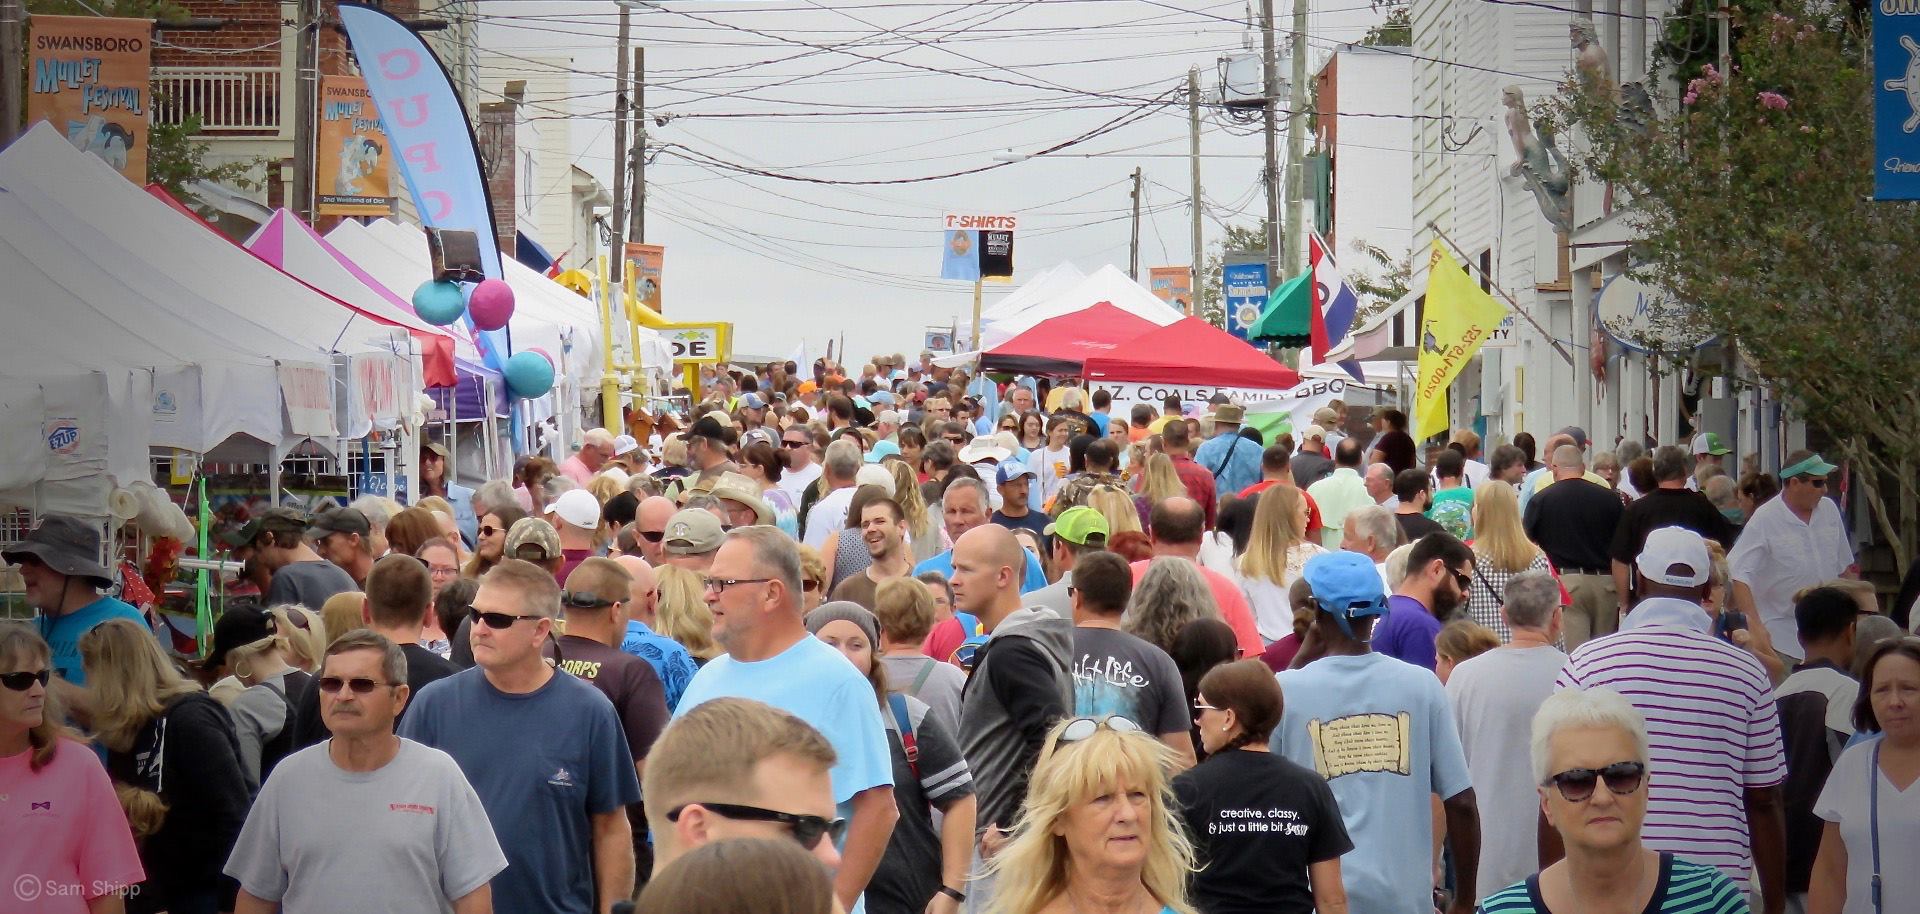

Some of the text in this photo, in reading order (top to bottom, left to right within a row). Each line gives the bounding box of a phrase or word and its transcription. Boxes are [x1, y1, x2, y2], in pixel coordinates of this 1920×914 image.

[37, 35, 143, 53] SWANSBORO
[82, 84, 143, 116] FESTIVAL
[946, 215, 1017, 229] T-SHIRTS
[1486, 328, 1510, 340] TY
[1136, 386, 1207, 402] COALS
[1220, 807, 1300, 821] creative. classy.
[1208, 822, 1217, 835] &
[1218, 821, 1236, 835] just
[1238, 824, 1246, 833] a
[1247, 821, 1269, 832] little
[1270, 821, 1283, 832] bit
